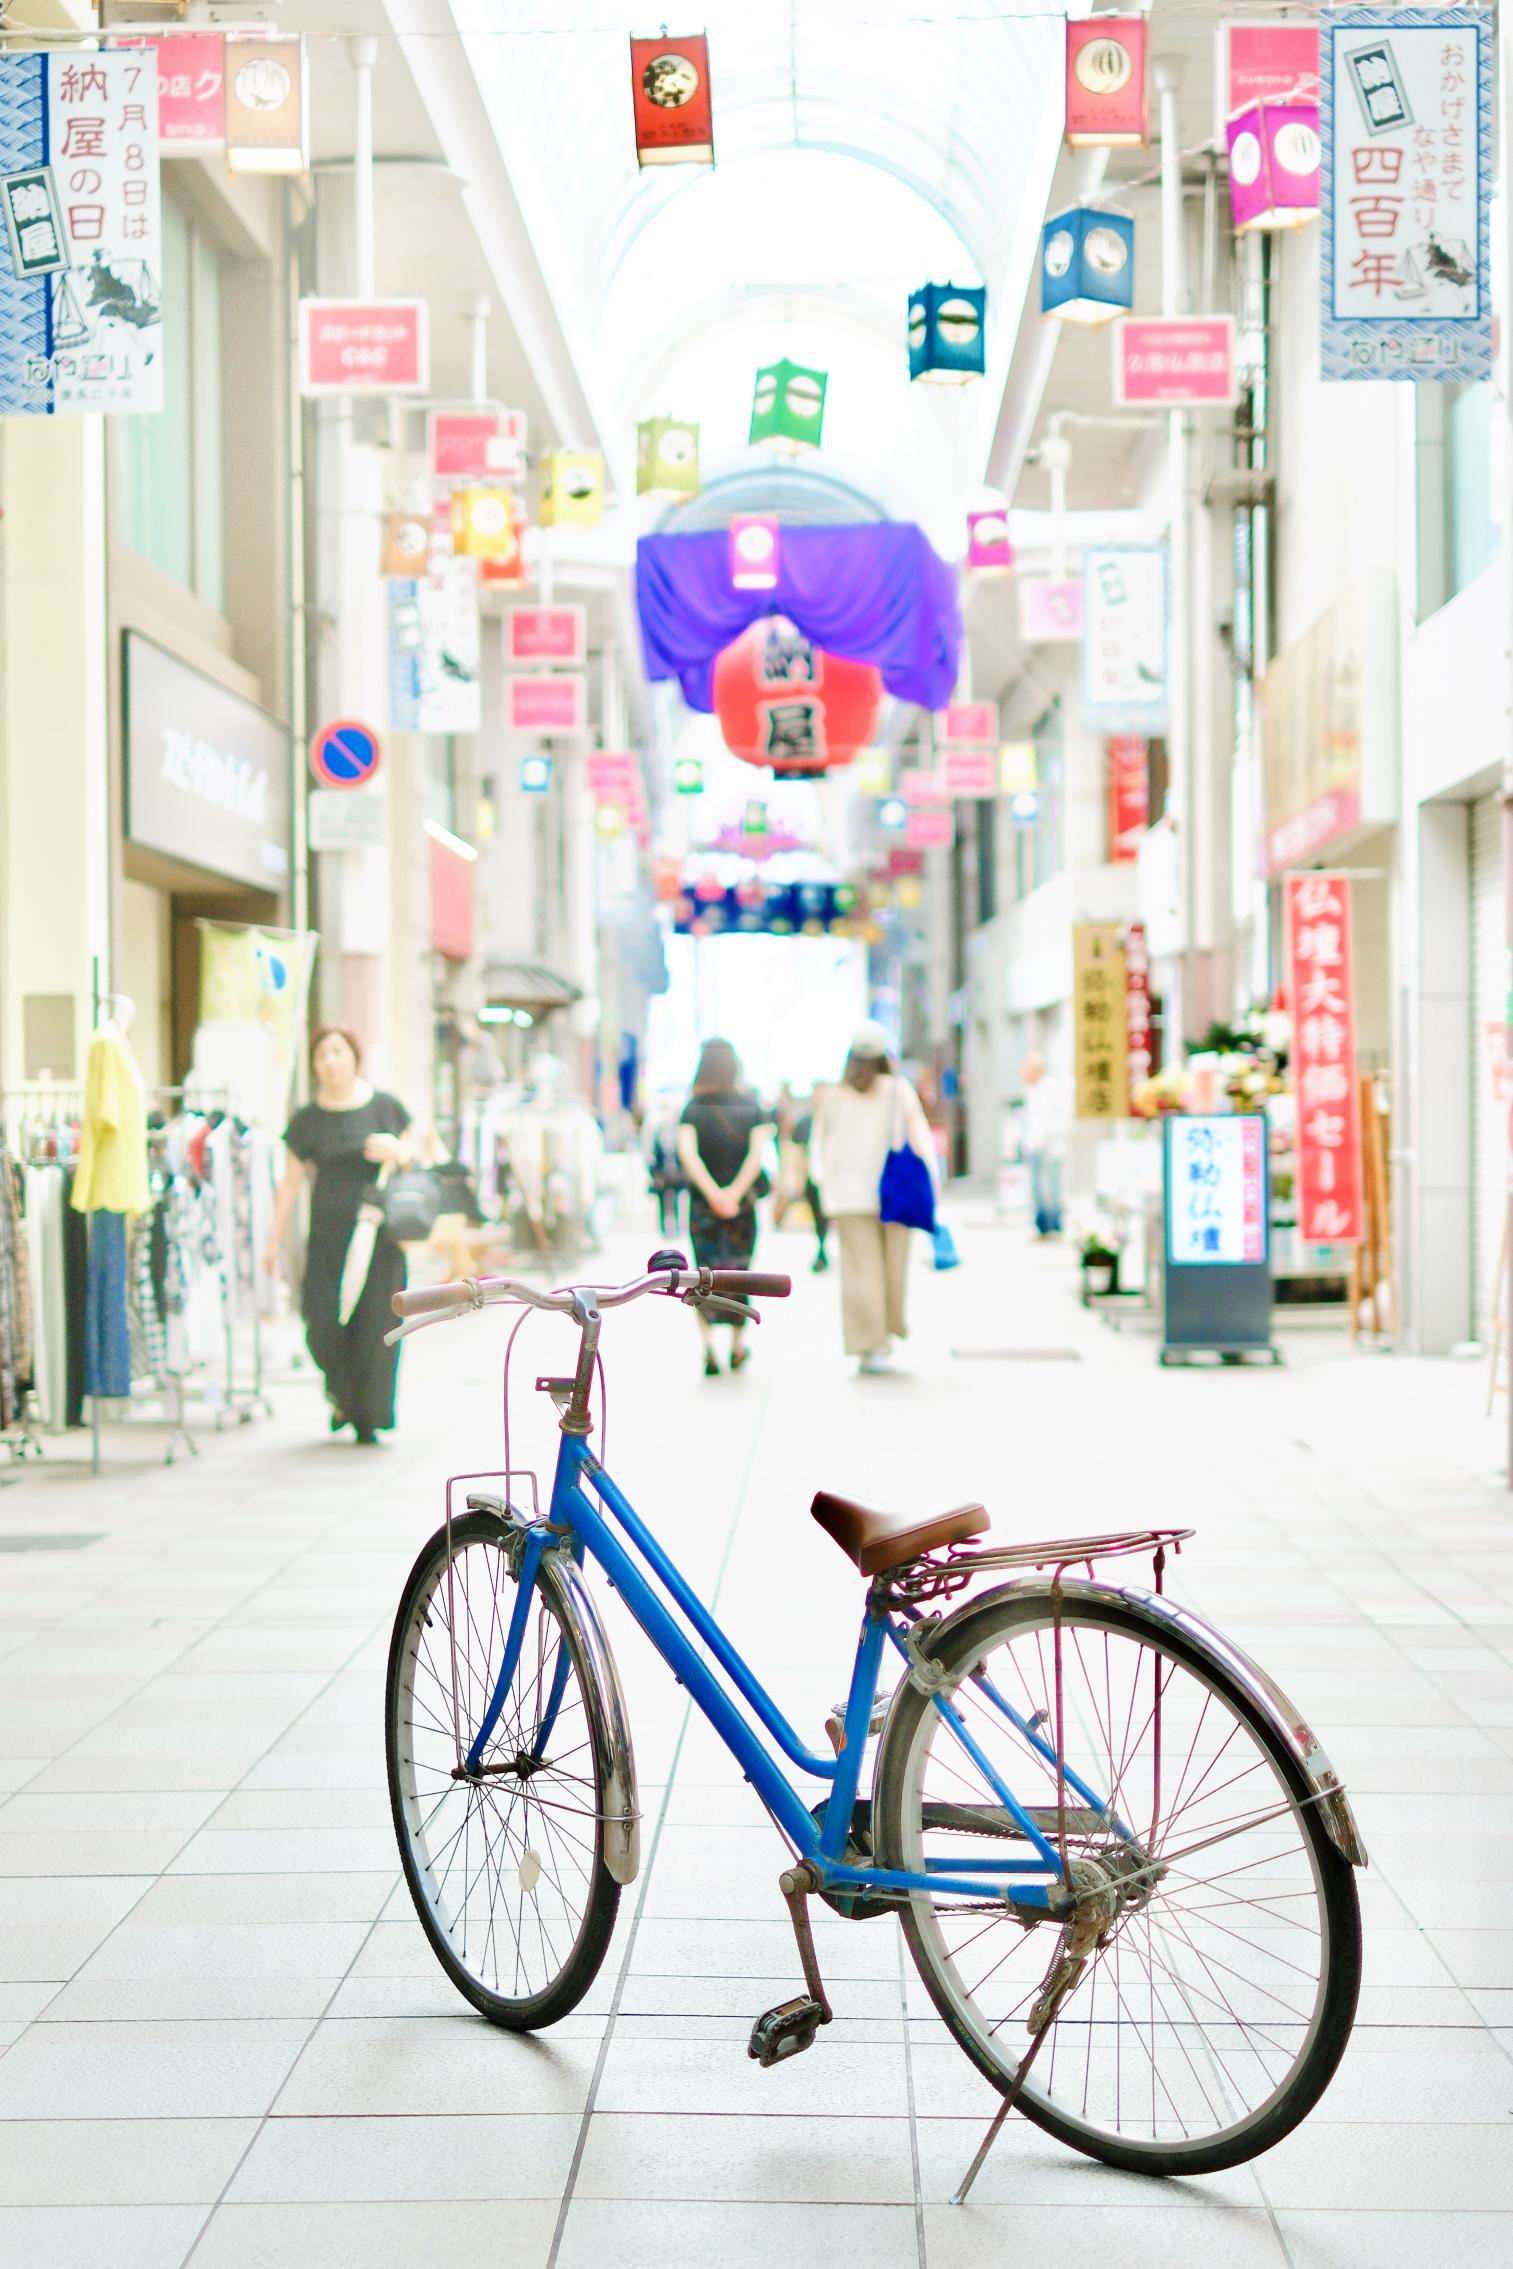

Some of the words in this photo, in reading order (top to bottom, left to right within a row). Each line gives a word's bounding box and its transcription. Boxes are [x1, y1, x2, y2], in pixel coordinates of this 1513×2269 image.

[60, 63, 108, 241] 納屋の日
[117, 66, 151, 240] 7月8日は
[1411, 123, 1439, 231] なや通り
[1439, 43, 1465, 202] おかげさまで
[1349, 146, 1405, 298] 四百年
[1294, 876, 1352, 1237] 仏壇大特価セール
